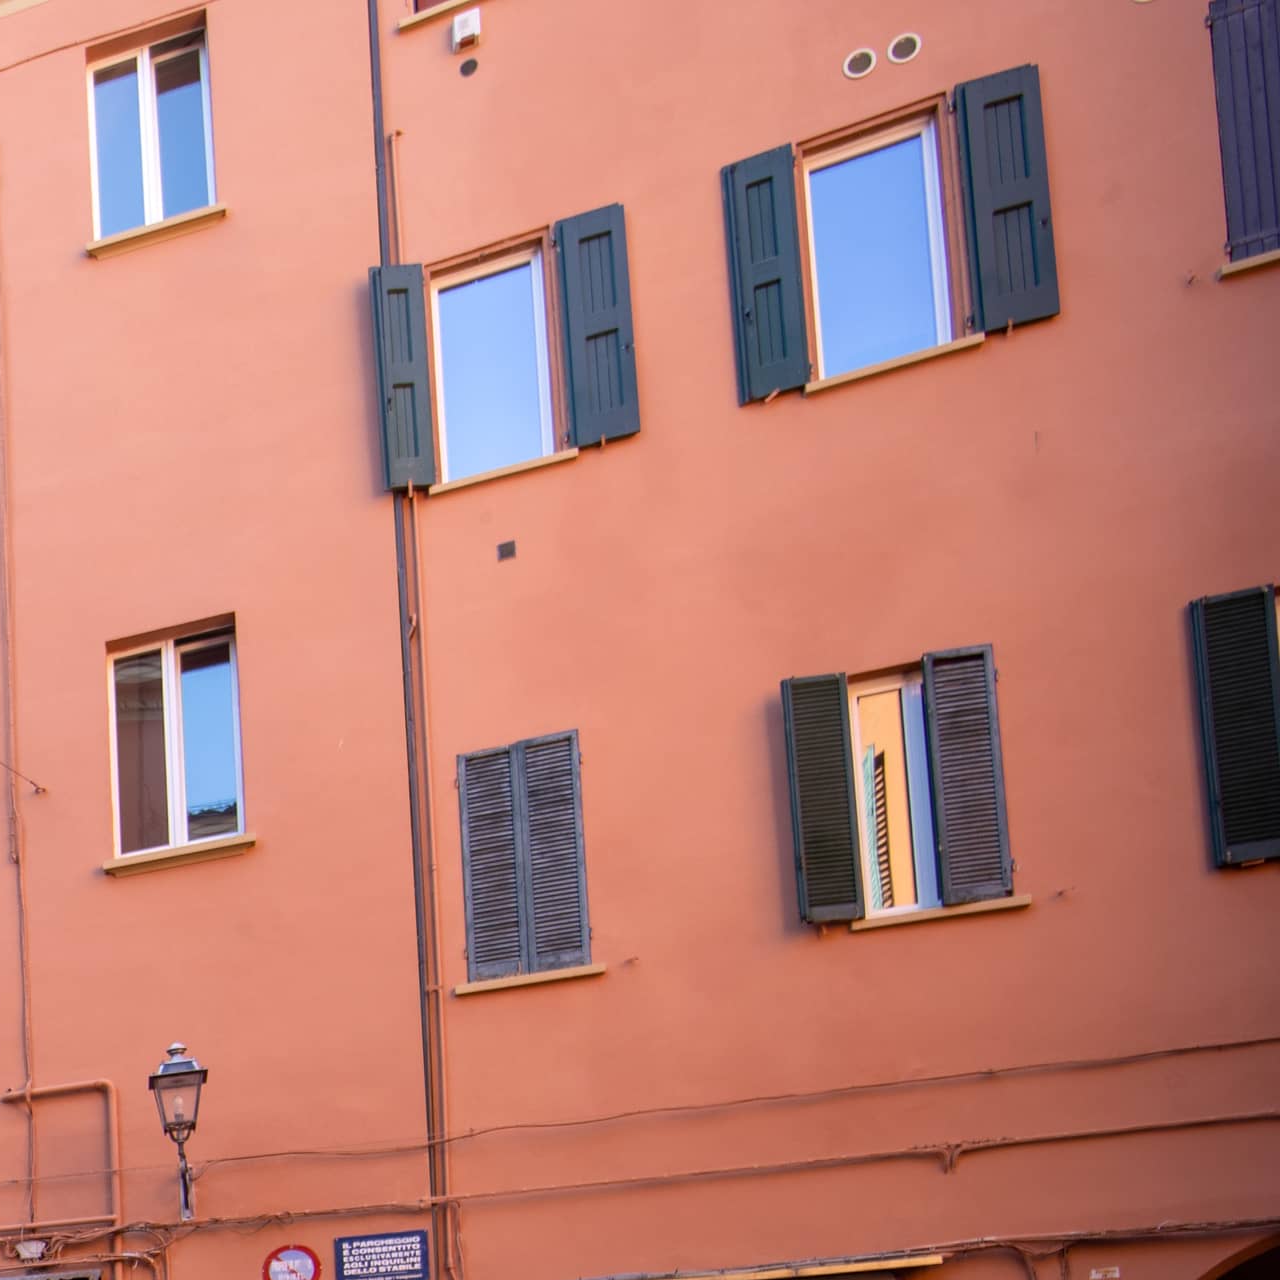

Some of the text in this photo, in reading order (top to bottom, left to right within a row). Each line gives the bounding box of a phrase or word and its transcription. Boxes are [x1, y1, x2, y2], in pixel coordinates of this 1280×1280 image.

[353, 1236, 421, 1248] PARCHEGGIO
[351, 1243, 421, 1255] CONSENTITO
[343, 1250, 422, 1262] ESCLUSIVAMENTE
[370, 1257, 422, 1266] INQUILINI
[344, 1263, 422, 1276] DELLO STABILE
